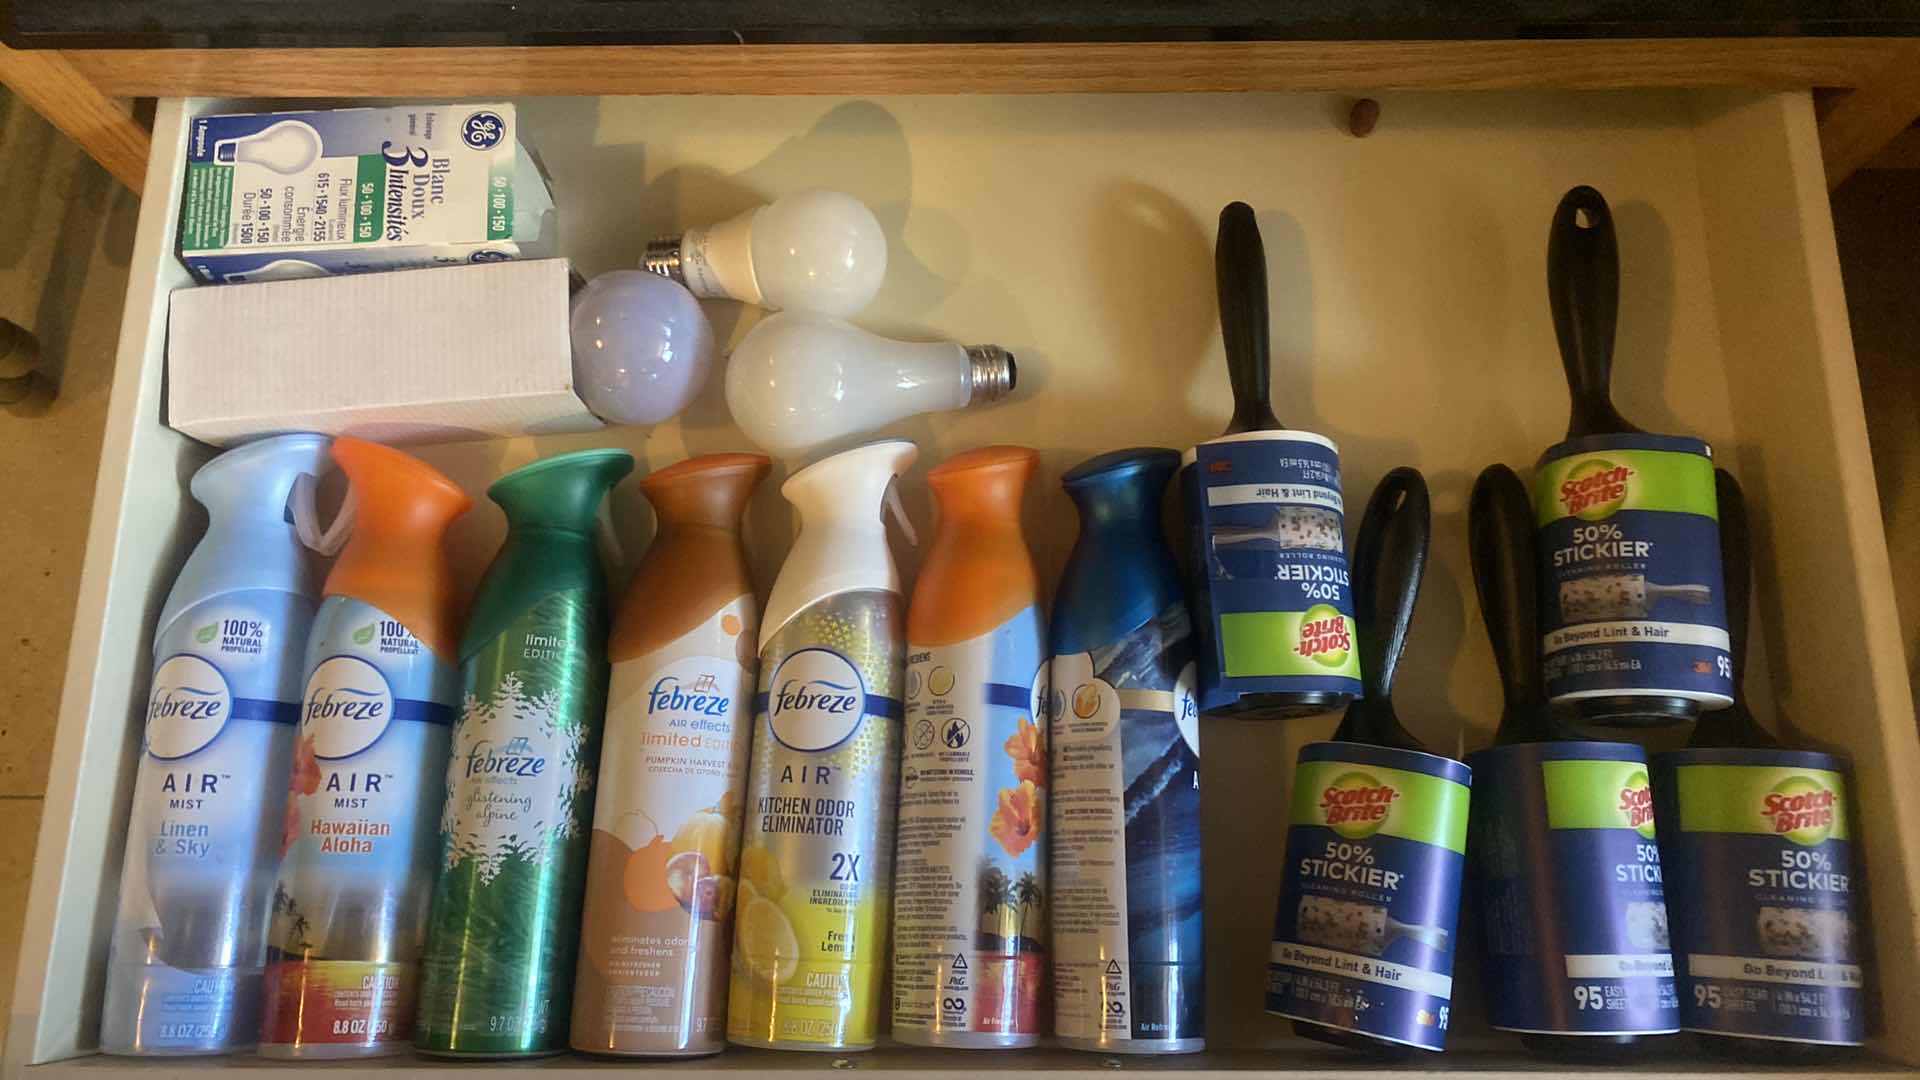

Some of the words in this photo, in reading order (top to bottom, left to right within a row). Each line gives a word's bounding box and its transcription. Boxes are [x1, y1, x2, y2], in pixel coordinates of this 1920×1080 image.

[382, 141, 429, 168] 3
[341, 178, 353, 197] Flux
[431, 159, 450, 204] Blanc
[242, 192, 257, 221] Durée
[387, 169, 409, 242] Intensités
[411, 173, 430, 220] Doux
[281, 186, 295, 243] consommée
[295, 206, 310, 242] Énergie
[336, 198, 349, 241] lumineux
[241, 222, 254, 244] 1500
[1256, 487, 1279, 499] Hair
[1281, 488, 1290, 499] &
[1291, 488, 1312, 500] Lint
[1568, 483, 1624, 516] Brite
[1573, 524, 1623, 544] 50%
[1301, 582, 1340, 601] 50%
[222, 619, 263, 637] 100%
[1302, 615, 1345, 638] Brite
[1563, 629, 1601, 643] Beyond
[1603, 626, 1627, 638] Lint
[1631, 626, 1641, 636] &
[1644, 626, 1670, 638] Hair
[221, 646, 262, 655] PROPELLANT
[222, 637, 263, 648] NATURAL
[381, 638, 419, 649] NATURAL
[148, 687, 223, 725] febreze
[648, 676, 729, 717] febreze
[774, 679, 856, 717] febreze
[304, 688, 385, 727] febreze
[669, 719, 688, 728] AIR
[690, 719, 731, 733] effects
[640, 731, 702, 748] limited
[466, 740, 545, 779] febreze
[645, 755, 687, 766] PUMPKIN
[690, 758, 726, 769] HARVEST
[169, 799, 205, 811] MIST
[334, 798, 368, 809] MIST
[758, 797, 811, 815] KITCHEN
[815, 797, 855, 818] ODOR
[1326, 804, 1386, 825] Brite
[1775, 810, 1831, 833] Brite
[160, 820, 210, 838] Linen
[311, 820, 390, 836] Hawaiian
[762, 815, 844, 836] ELIMINATOR
[155, 840, 167, 855] &
[175, 840, 211, 859] Sky
[320, 836, 373, 853] Aloha
[1325, 840, 1374, 865] 50%
[830, 852, 860, 882] 2X
[1781, 850, 1831, 871] 50%
[1294, 950, 1332, 966] Beyond
[1335, 957, 1359, 973] Lint
[1362, 963, 1371, 975] &
[1375, 965, 1402, 981] Hair
[1744, 963, 1762, 975] Go
[1766, 965, 1815, 980] Beyond
[1573, 985, 1604, 1011] 95
[1694, 984, 1721, 1009] 95
[333, 1020, 350, 1035] 8.8
[350, 1020, 366, 1034] OZ
